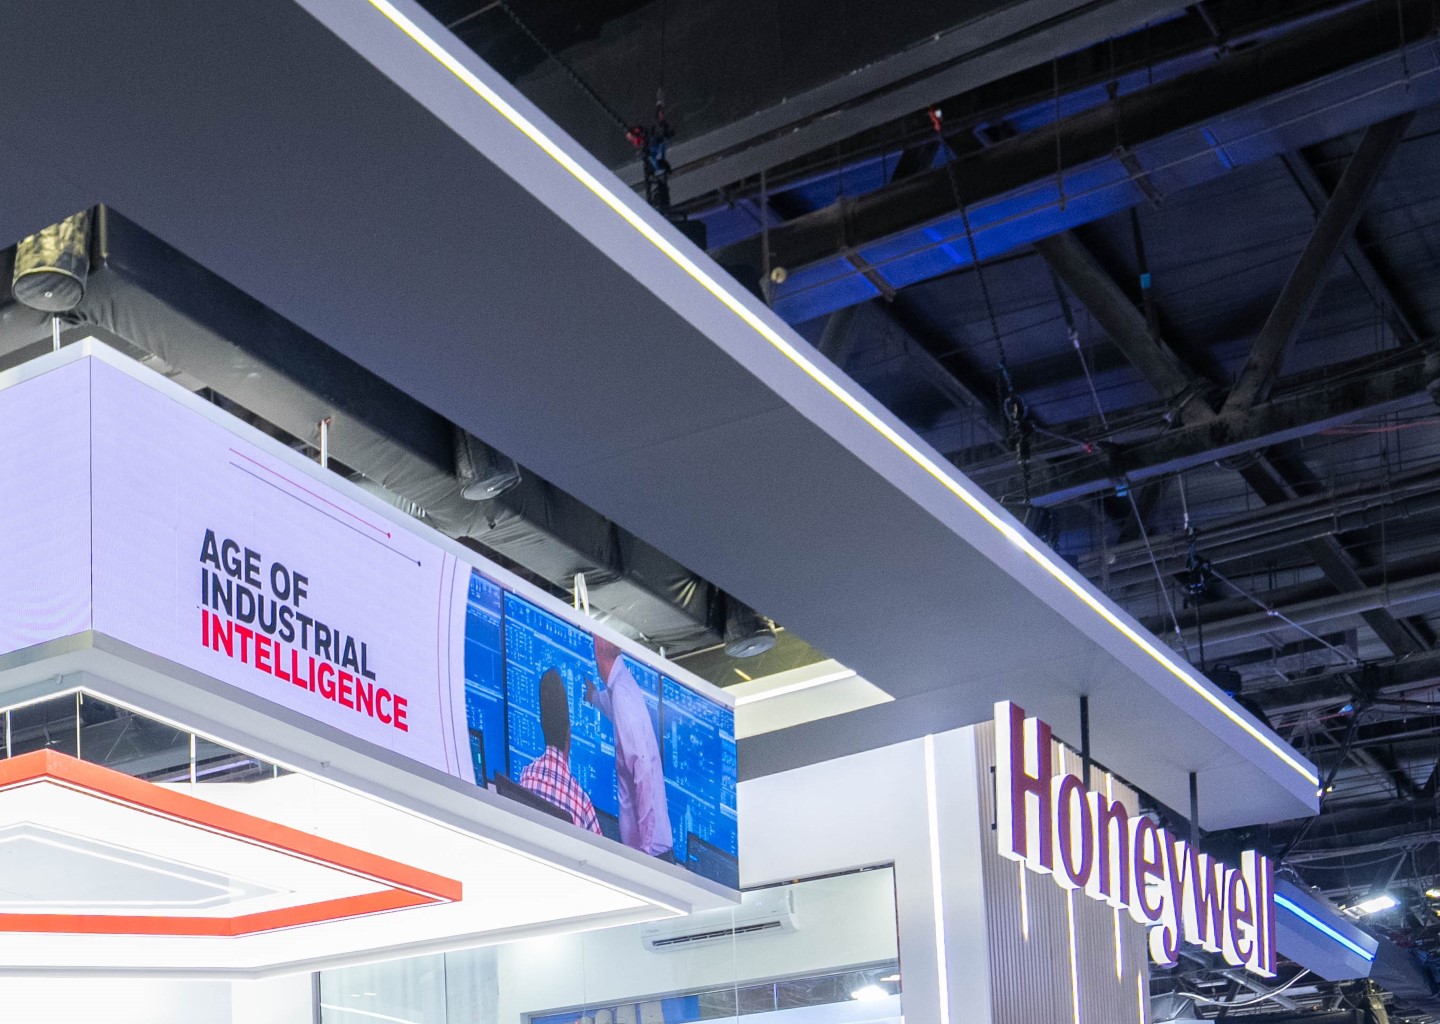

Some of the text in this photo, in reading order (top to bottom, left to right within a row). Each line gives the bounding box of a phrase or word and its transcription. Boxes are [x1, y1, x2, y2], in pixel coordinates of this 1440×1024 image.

[200, 529, 308, 608] AGE OF
[202, 568, 377, 682] INDUSTRIAL
[201, 608, 409, 733] INTELLIGENCE
[994, 700, 1277, 978] Honeywell
